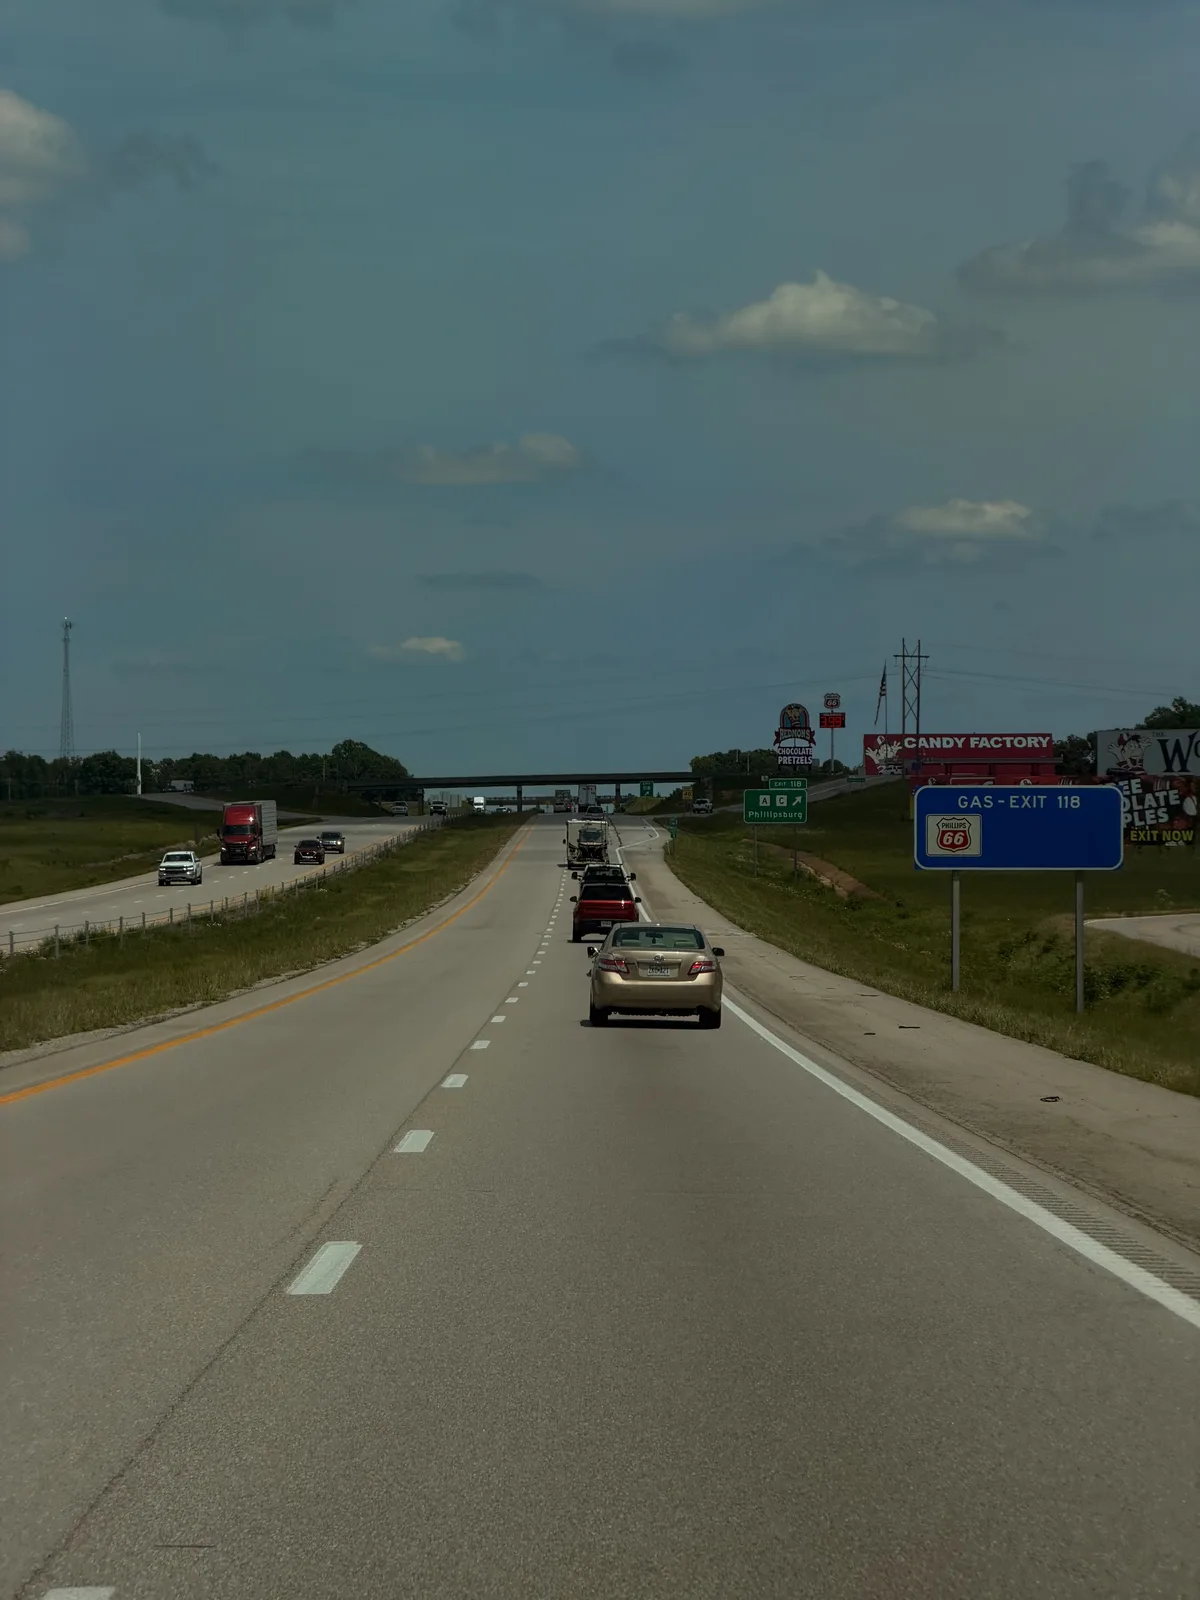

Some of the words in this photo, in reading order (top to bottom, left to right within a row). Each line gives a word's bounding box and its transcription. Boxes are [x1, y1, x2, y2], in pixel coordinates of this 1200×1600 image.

[779, 729, 811, 740] REDMONS
[903, 737, 967, 749] CANDY
[969, 736, 1051, 749] FACTORY
[778, 748, 812, 756] CHOCOLATE
[778, 757, 812, 765] PRETZELS
[1057, 795, 1081, 809] 118
[748, 810, 803, 820] Phillipsburg
[943, 831, 964, 845] 66
[1130, 830, 1159, 841] EXIT
[1162, 830, 1194, 841] NOW
